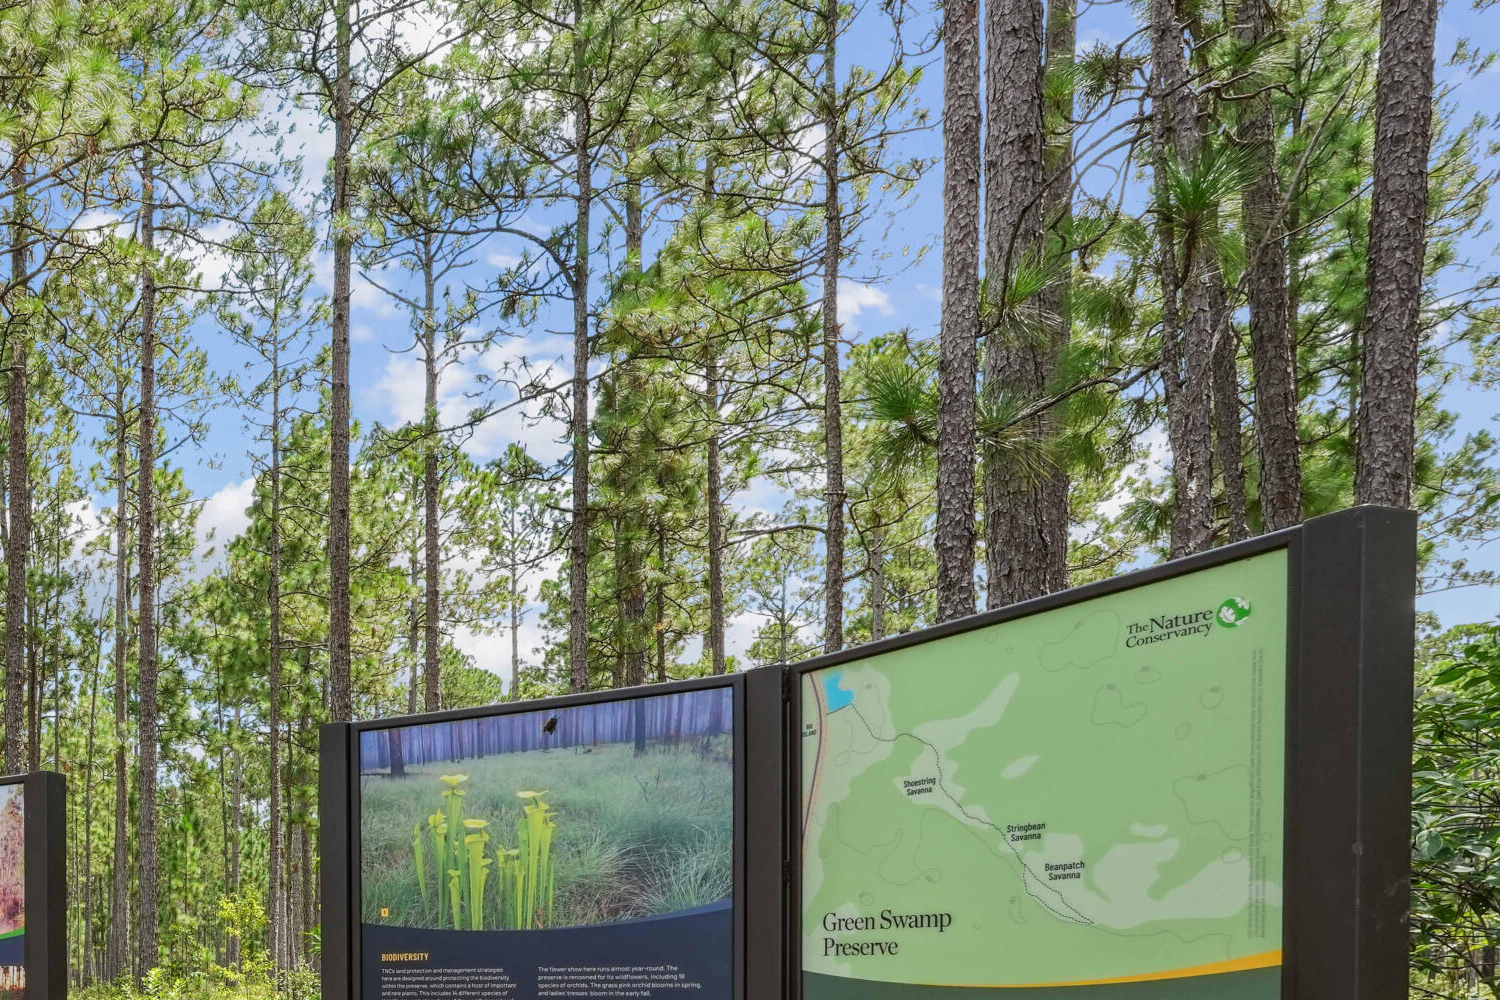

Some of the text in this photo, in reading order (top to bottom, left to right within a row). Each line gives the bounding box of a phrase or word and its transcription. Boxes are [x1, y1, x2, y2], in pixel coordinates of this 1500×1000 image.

[1126, 609, 1213, 634] The Nature
[1125, 622, 1213, 648] Conservancy
[903, 777, 936, 788] Shoestring
[907, 787, 932, 796] Savanna
[1007, 823, 1046, 833] Stringbean
[1011, 833, 1041, 842] Savanna
[1045, 861, 1085, 872] Beanpatch
[1049, 872, 1081, 881] Savanna
[823, 909, 952, 932] Green Swamp
[823, 937, 898, 956] Preserve
[381, 952, 429, 961] BIODIVERSITY
